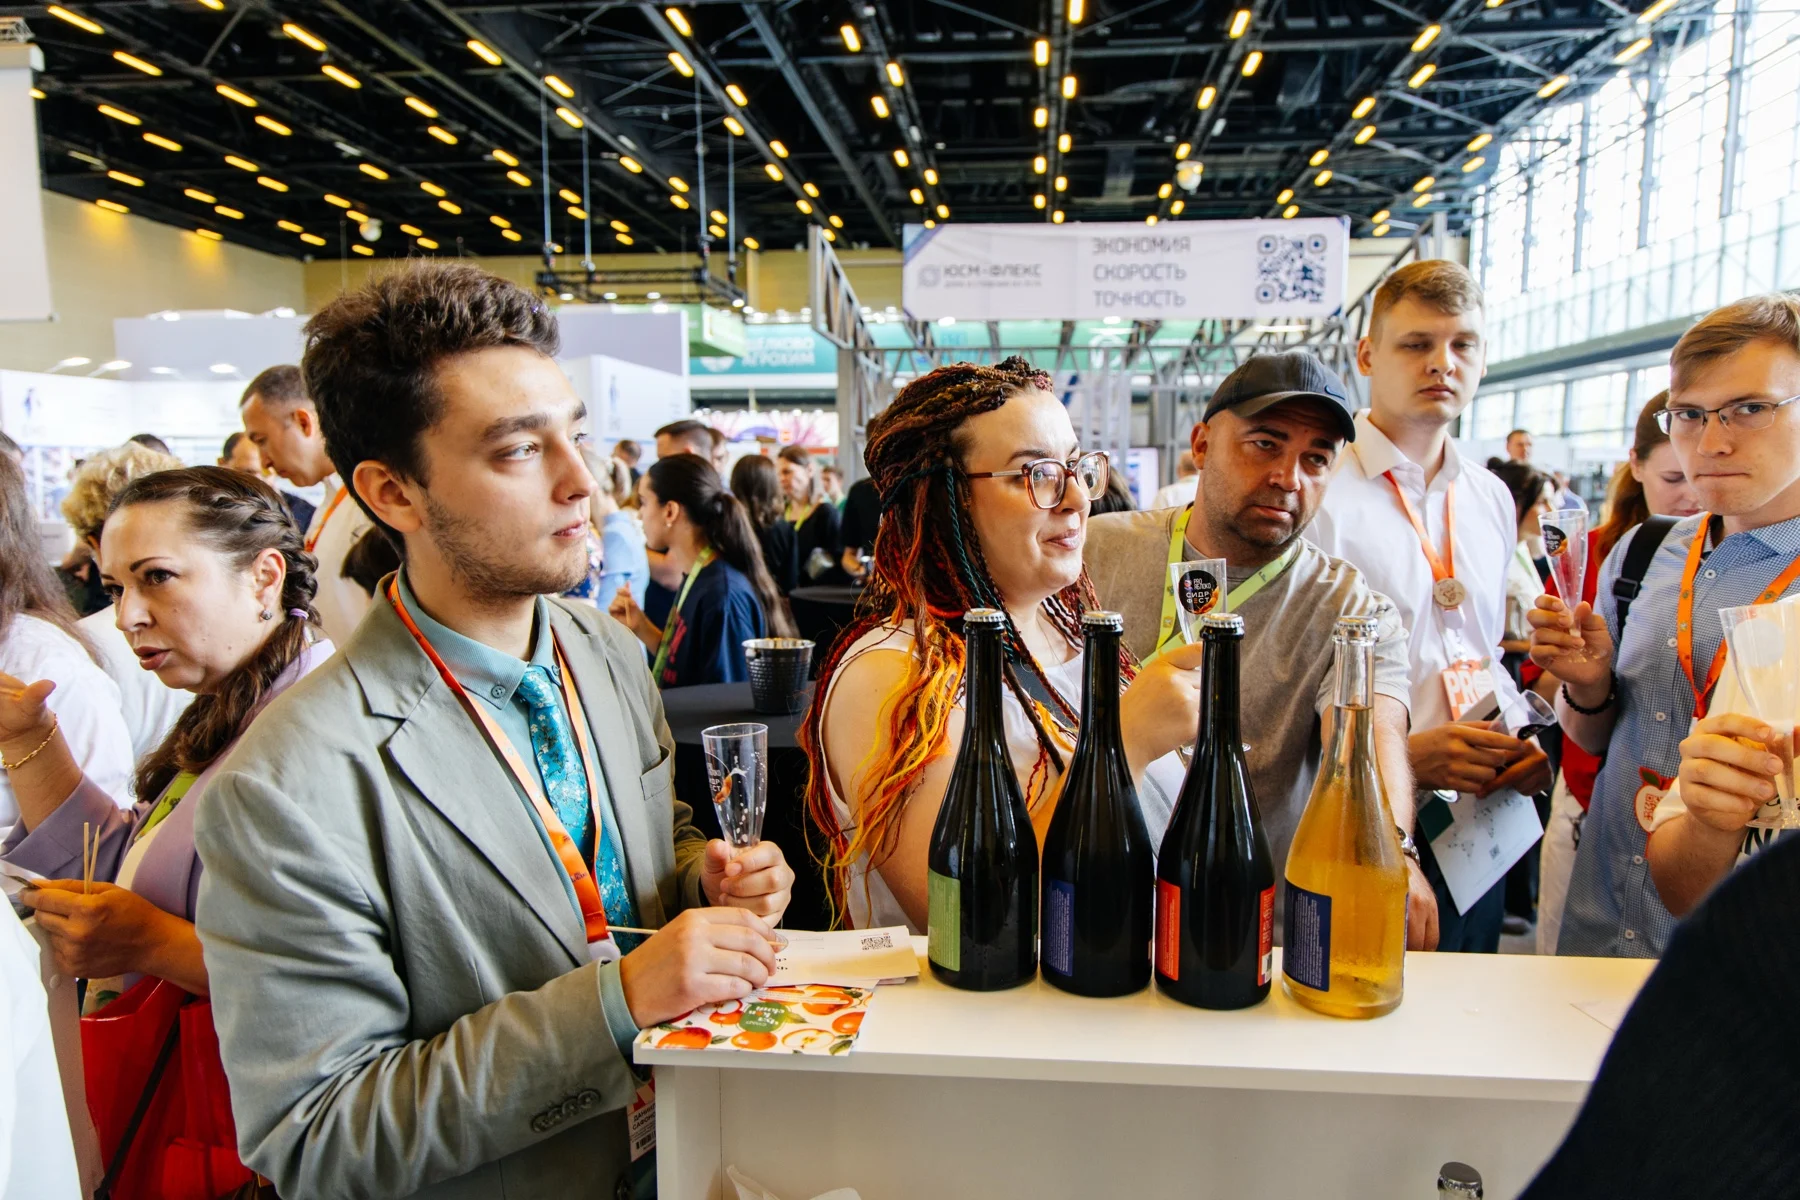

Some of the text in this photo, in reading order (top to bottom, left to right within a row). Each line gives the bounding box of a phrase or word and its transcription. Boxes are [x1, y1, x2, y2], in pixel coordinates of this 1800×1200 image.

[1092, 236, 1191, 255] ЭКОНОМИЯ
[1094, 263, 1187, 282] СКОРОСТЬ
[1093, 290, 1187, 308] ТОЧНОСТЬ
